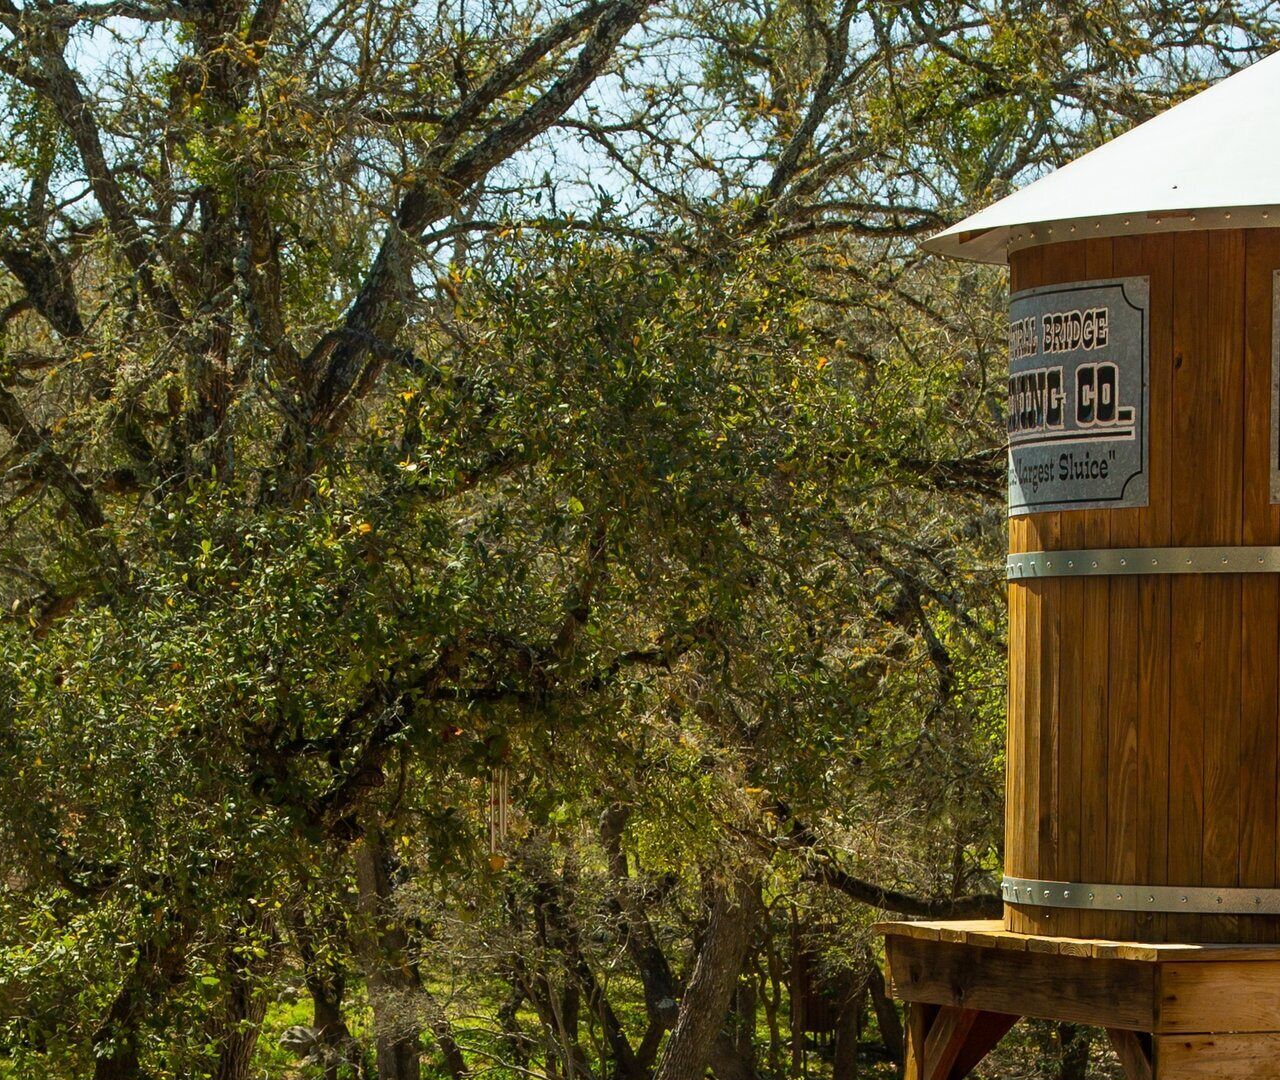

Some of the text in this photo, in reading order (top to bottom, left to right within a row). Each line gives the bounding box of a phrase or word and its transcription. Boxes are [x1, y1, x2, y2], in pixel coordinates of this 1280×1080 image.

[1041, 307, 1109, 354] BRIDGE
[1075, 361, 1136, 428] CO.
[1058, 450, 1116, 481] Sluice"
